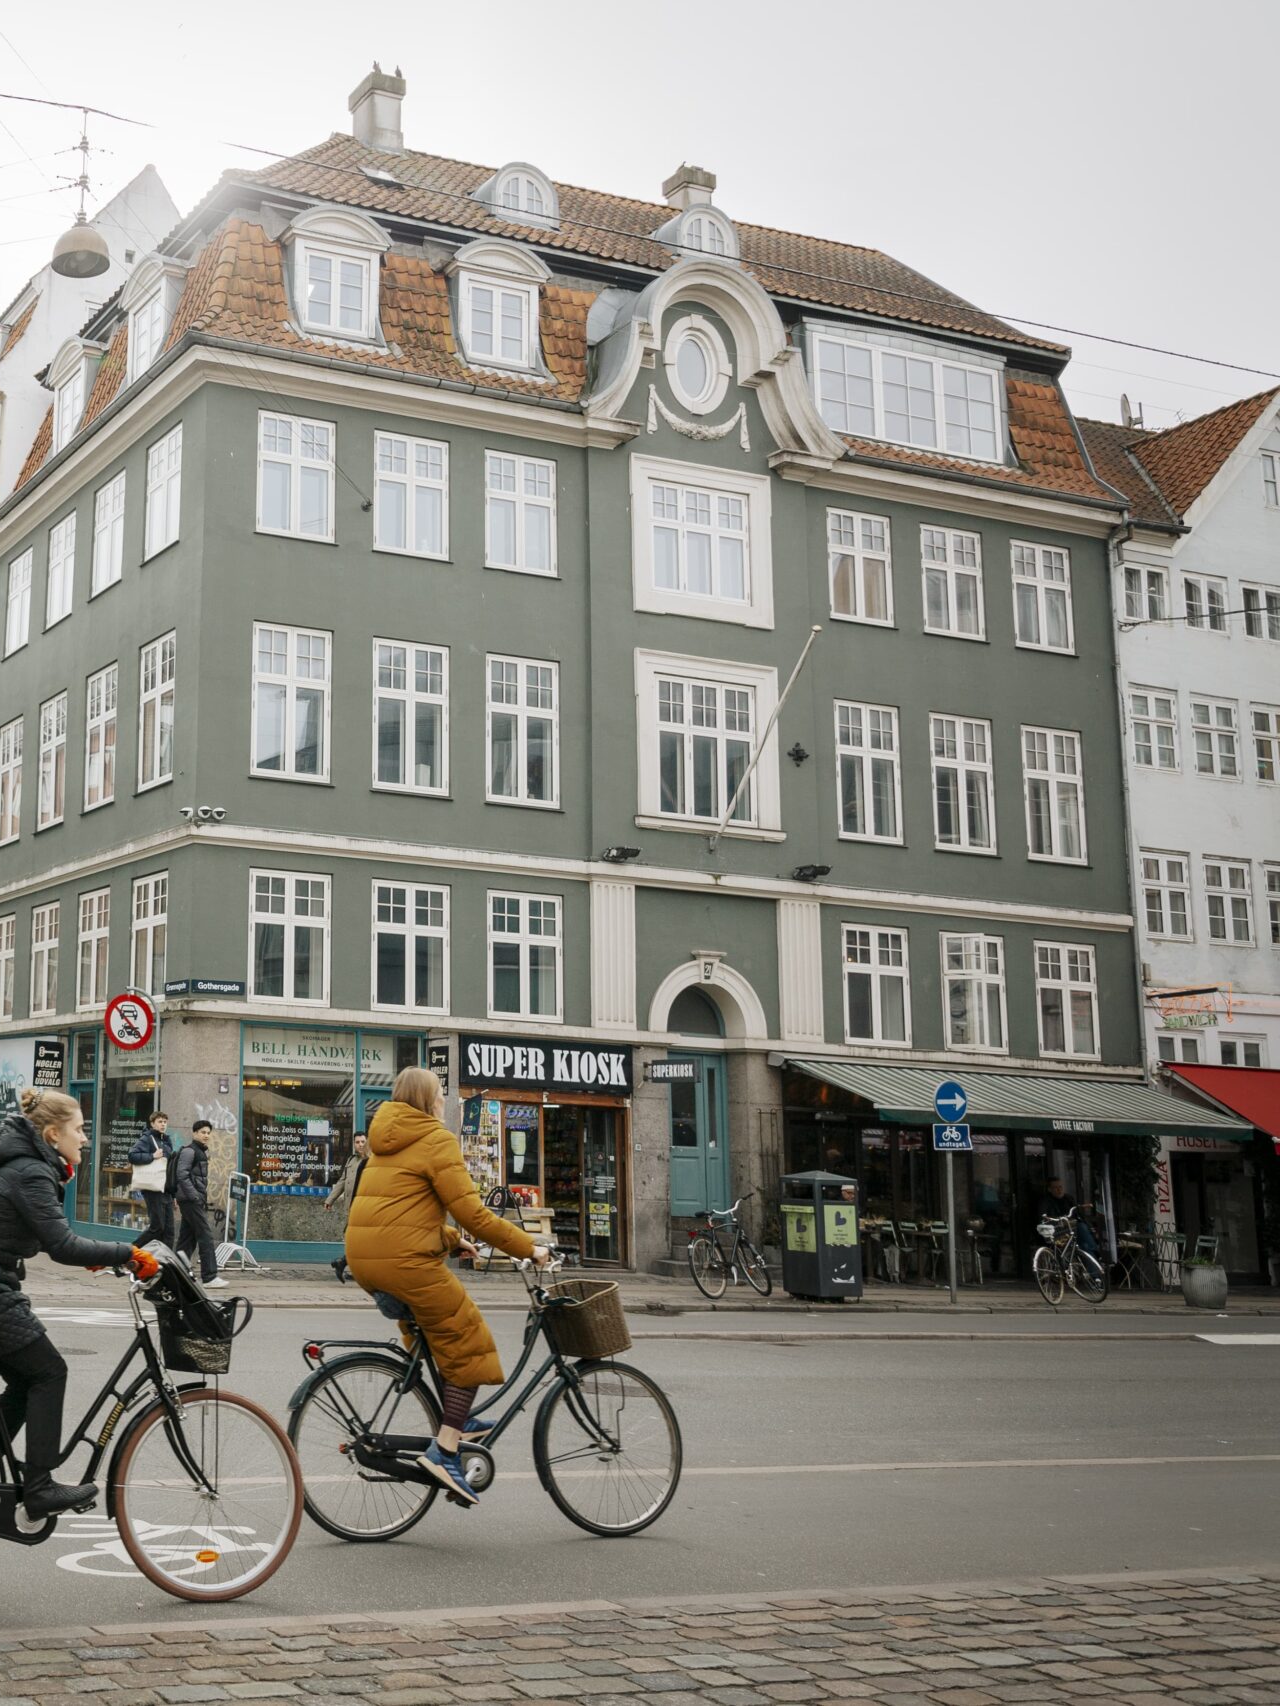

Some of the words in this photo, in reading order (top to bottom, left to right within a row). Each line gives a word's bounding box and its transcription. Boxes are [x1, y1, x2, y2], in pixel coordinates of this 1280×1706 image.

[197, 982, 240, 992] Gothersgade
[251, 1041, 290, 1055] BELL
[36, 1060, 62, 1069] NØGLER
[468, 1043, 546, 1081] SUPER
[552, 1049, 627, 1086] KIOSK
[37, 1070, 59, 1078] STORT
[652, 1064, 694, 1078] SUPERKIOSK
[35, 1078, 61, 1086] UDVALG
[1052, 1119, 1071, 1130] COFFEE
[1073, 1121, 1094, 1132] FACTORY
[297, 1128, 307, 1136] og
[1153, 1160, 1171, 1214] PIZZA
